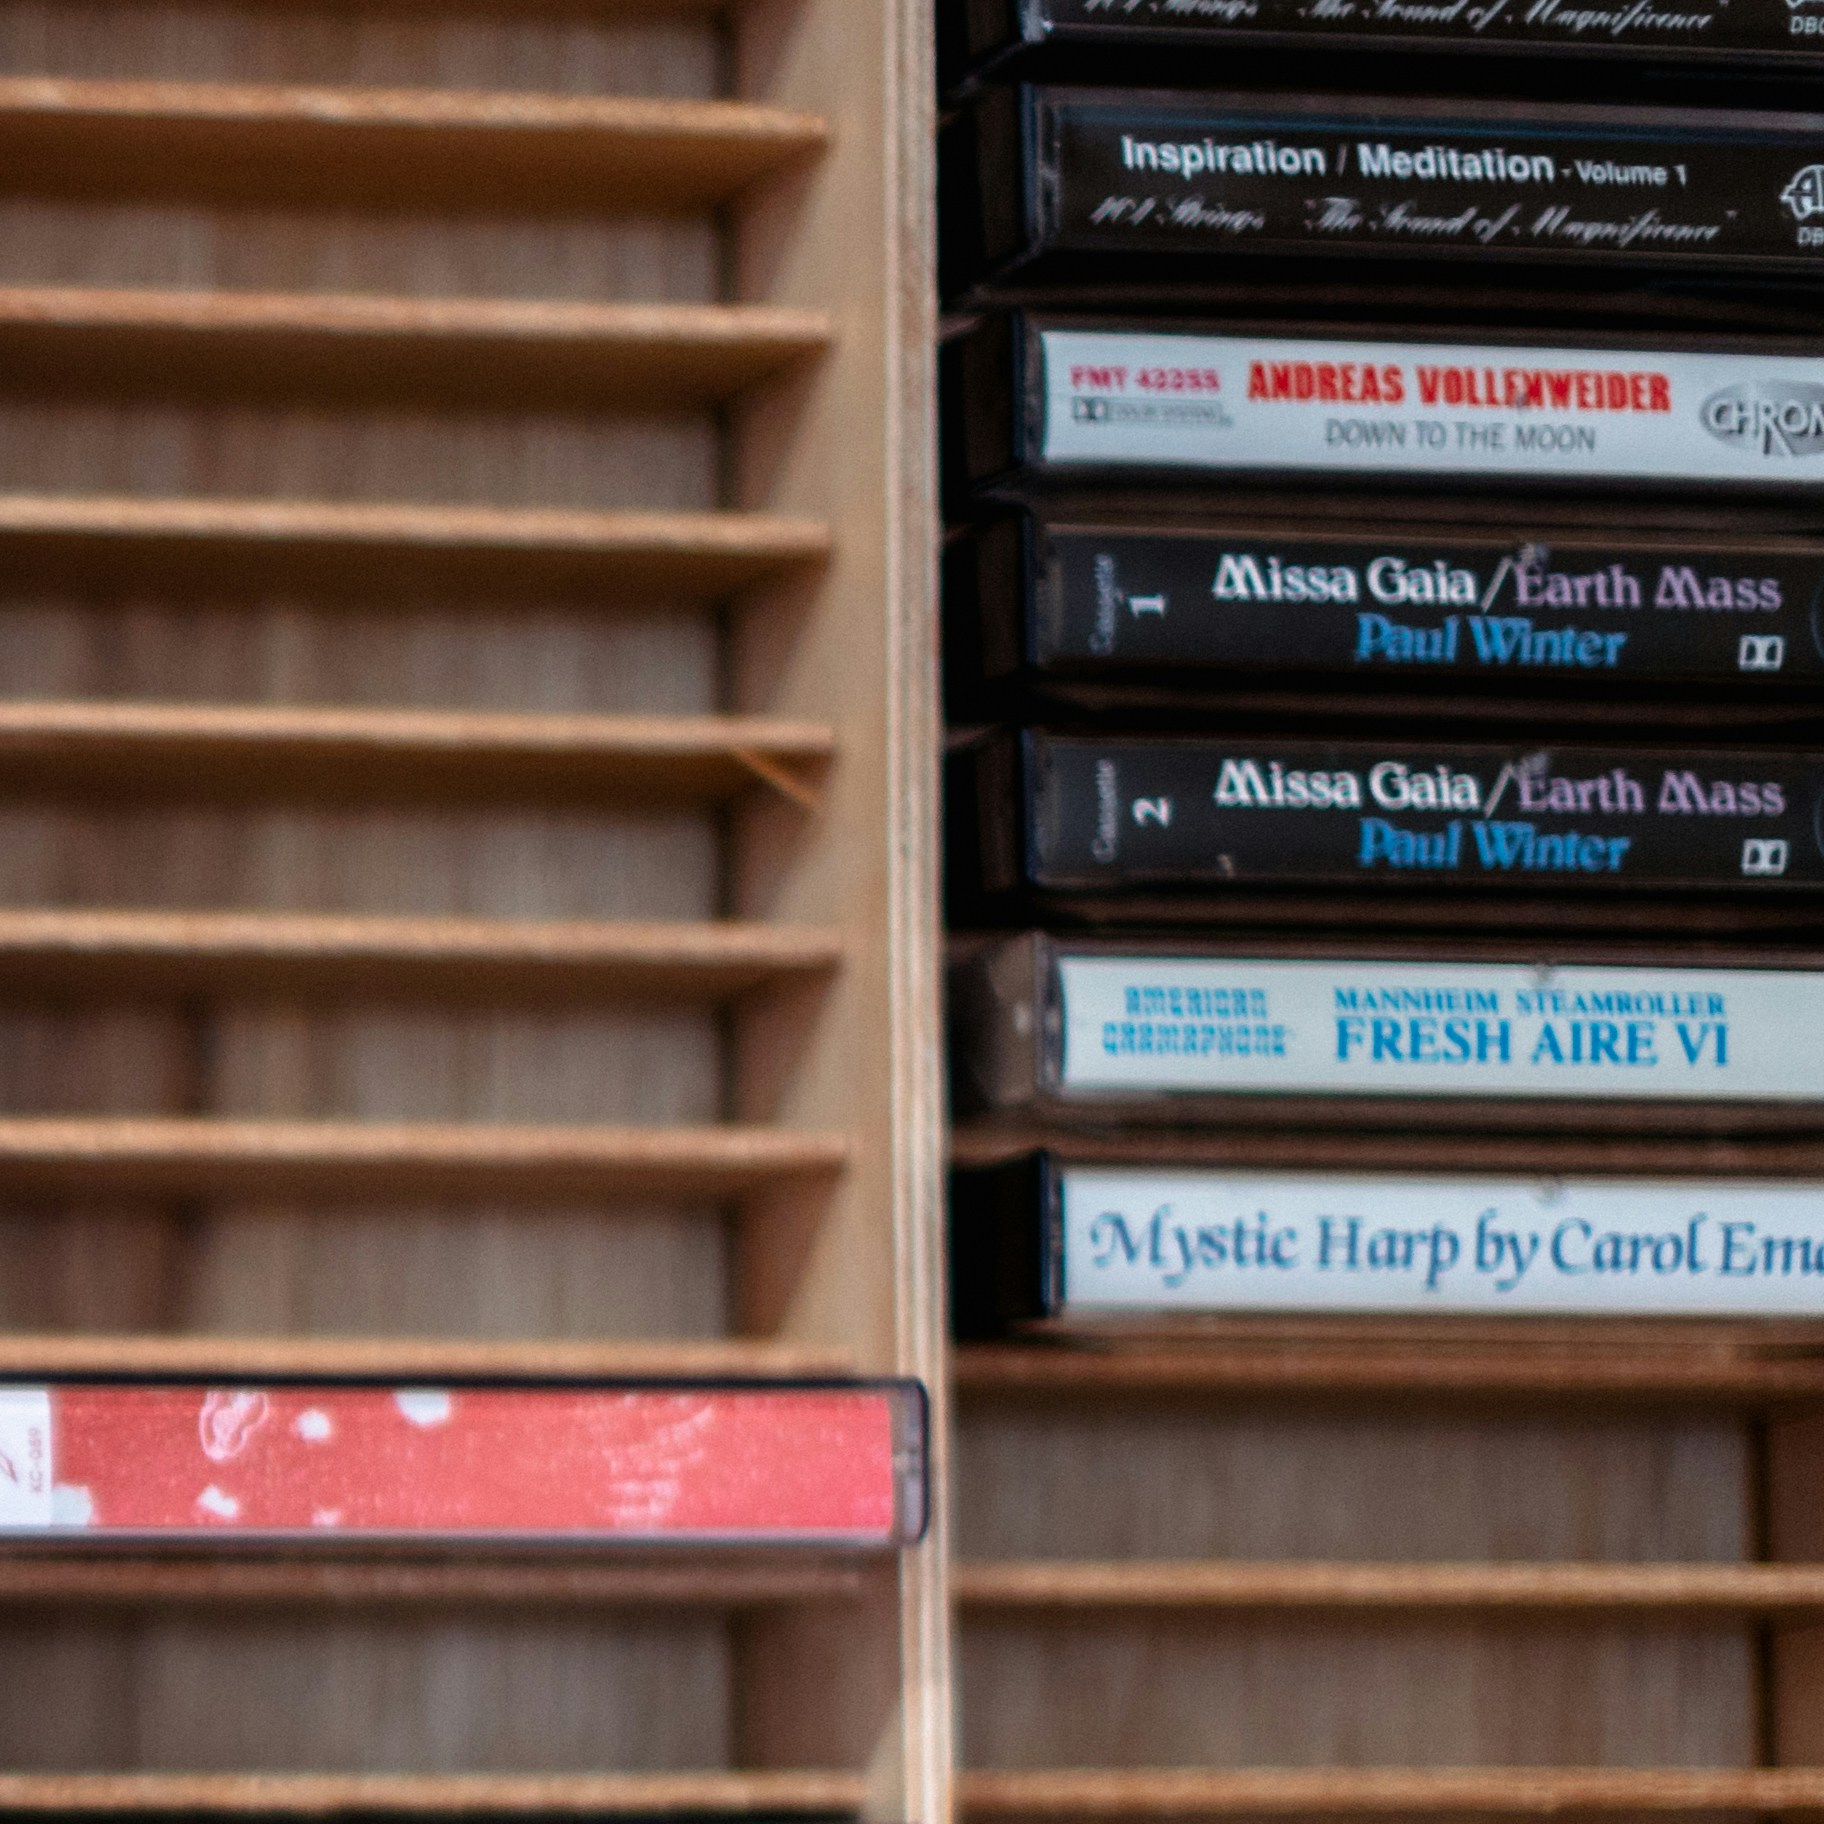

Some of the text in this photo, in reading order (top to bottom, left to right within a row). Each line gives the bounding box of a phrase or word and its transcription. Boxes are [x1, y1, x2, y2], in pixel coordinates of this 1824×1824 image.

[1121, 134, 1327, 177] Inspiration
[1336, 144, 1348, 175] /
[1358, 141, 1554, 184] Meditation
[1574, 160, 1669, 188] Volume
[1675, 163, 1689, 186] 1
[1246, 360, 1672, 414] ANDREAS VOLLENWEIDER
[1325, 418, 1597, 454] DOWN TO THE MOON
[1212, 554, 1355, 602] Missa
[1654, 565, 1783, 612] Mass
[1354, 614, 1628, 669] Paul Winter
[1135, 798, 1171, 828] 2
[1214, 757, 1357, 807] Missa
[1658, 769, 1786, 817] Mass
[1359, 819, 1631, 873] Paul Winter
[1334, 987, 1727, 1018] MANNHEIM STEAMROLLER
[1335, 1018, 1729, 1067] FRESH AIRE VI
[1090, 1206, 1296, 1288] Mystic
[1317, 1213, 1459, 1293] Harp
[1475, 1208, 1542, 1292] by
[1551, 1213, 1708, 1276] Carol
